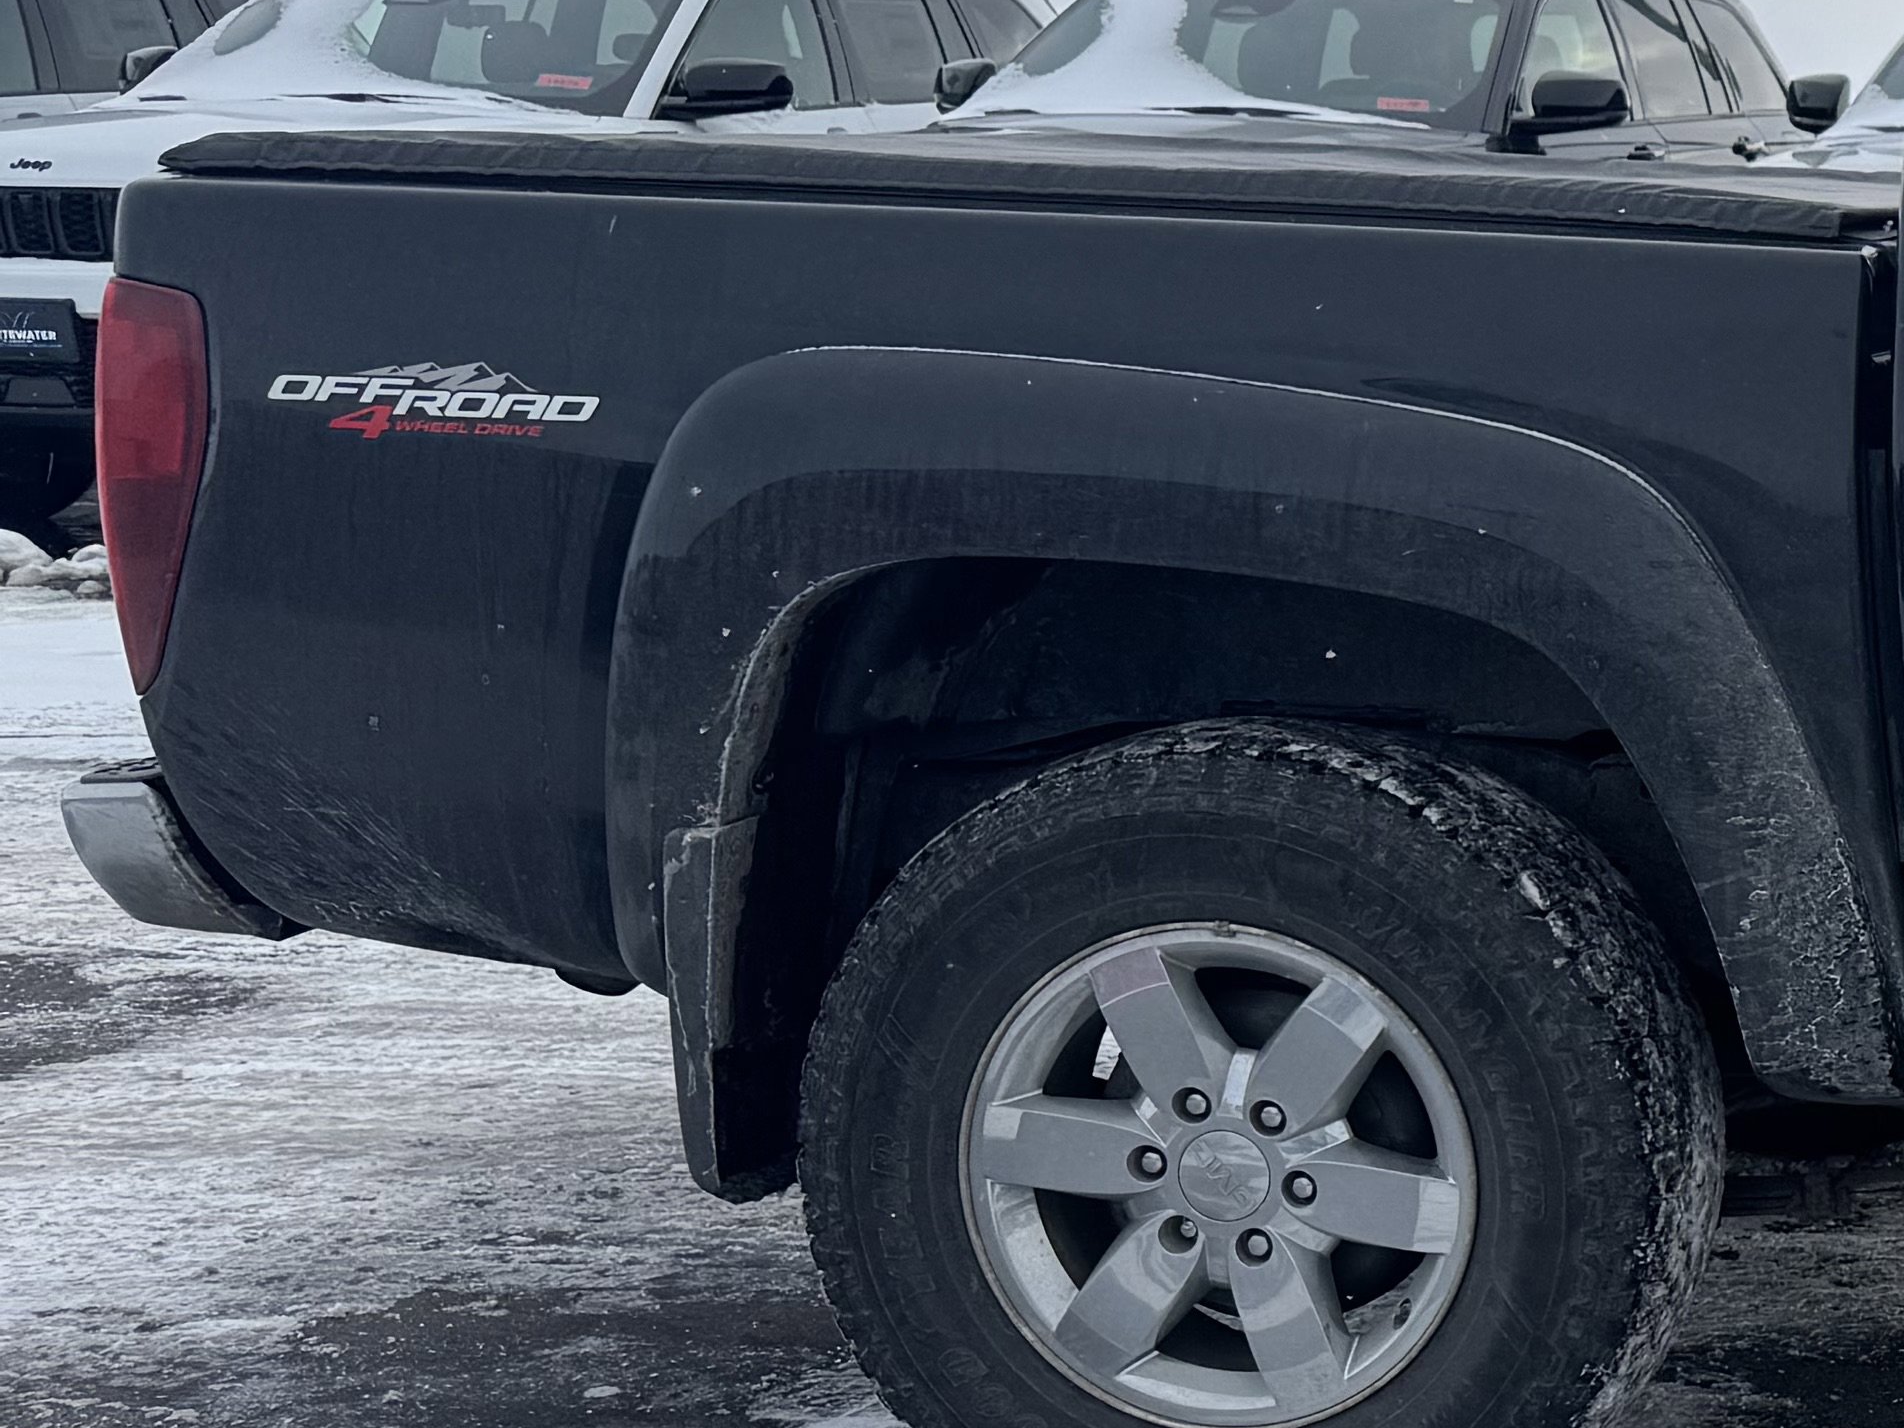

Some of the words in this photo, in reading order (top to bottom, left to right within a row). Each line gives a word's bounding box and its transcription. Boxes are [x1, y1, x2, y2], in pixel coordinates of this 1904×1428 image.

[10, 158, 52, 172] Jeep
[329, 405, 393, 439] 4
[395, 420, 468, 434] WHEEL
[474, 423, 545, 437] DRIVE
